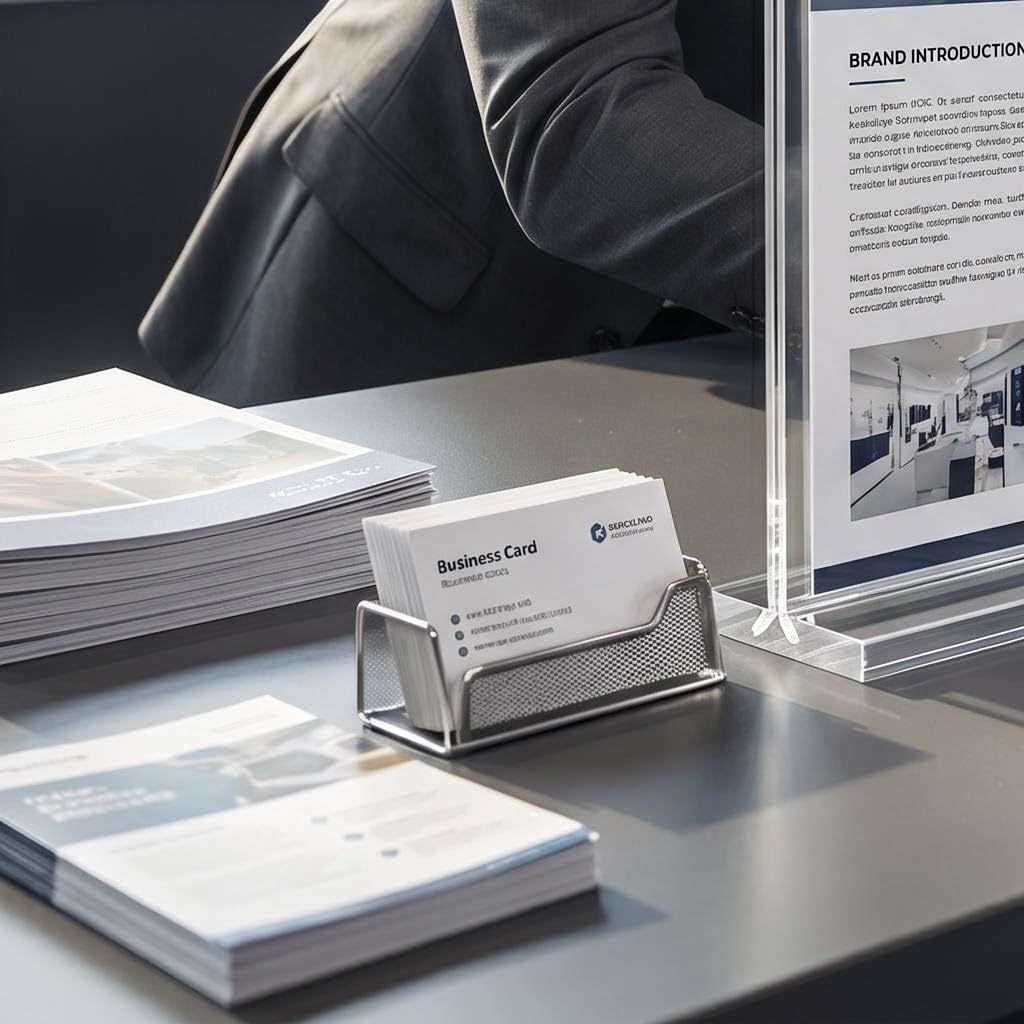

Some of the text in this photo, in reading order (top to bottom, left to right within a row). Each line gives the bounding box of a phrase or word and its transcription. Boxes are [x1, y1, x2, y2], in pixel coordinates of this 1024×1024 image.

[849, 49, 907, 68] BRAND
[848, 103, 878, 115] Lorem
[437, 539, 538, 574] Business Card
